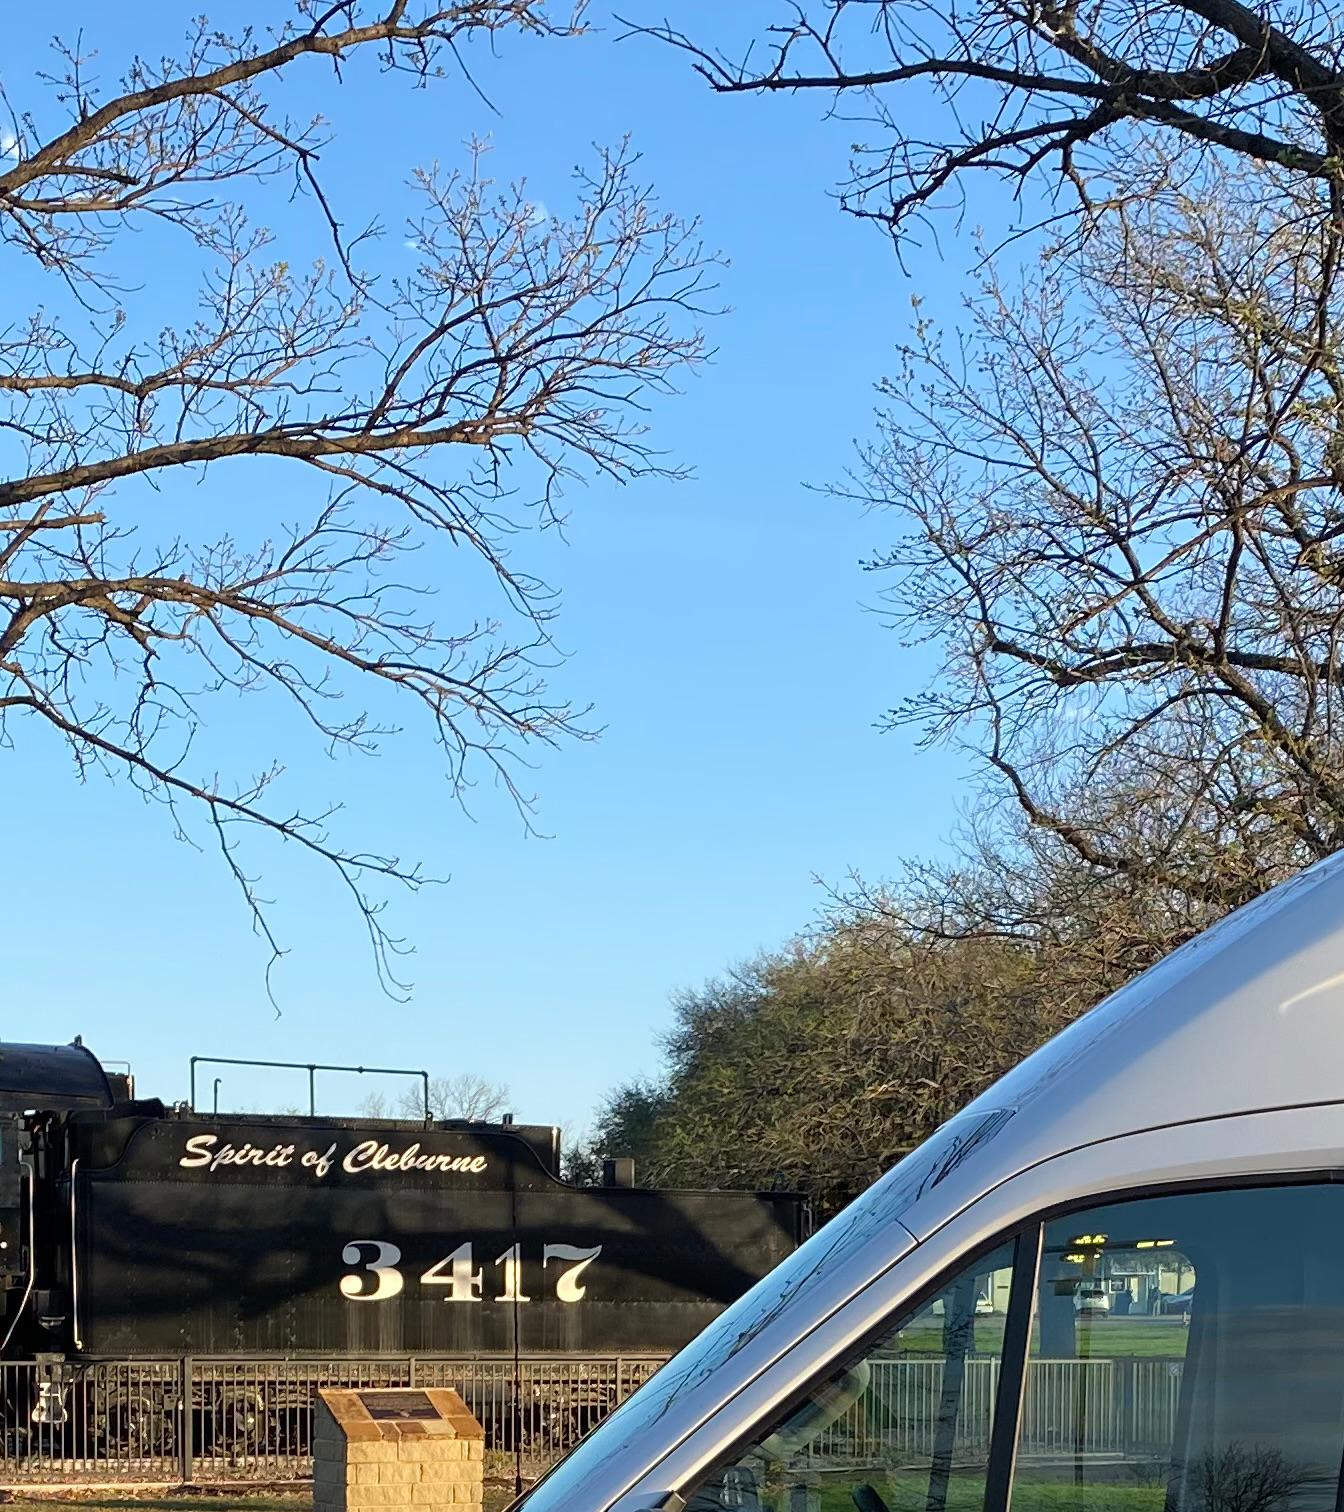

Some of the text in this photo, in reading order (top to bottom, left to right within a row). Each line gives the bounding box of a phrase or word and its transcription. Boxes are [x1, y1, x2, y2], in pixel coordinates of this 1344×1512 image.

[179, 1134, 489, 1178] Spirit of Cleburne
[339, 1239, 603, 1304] 3417
